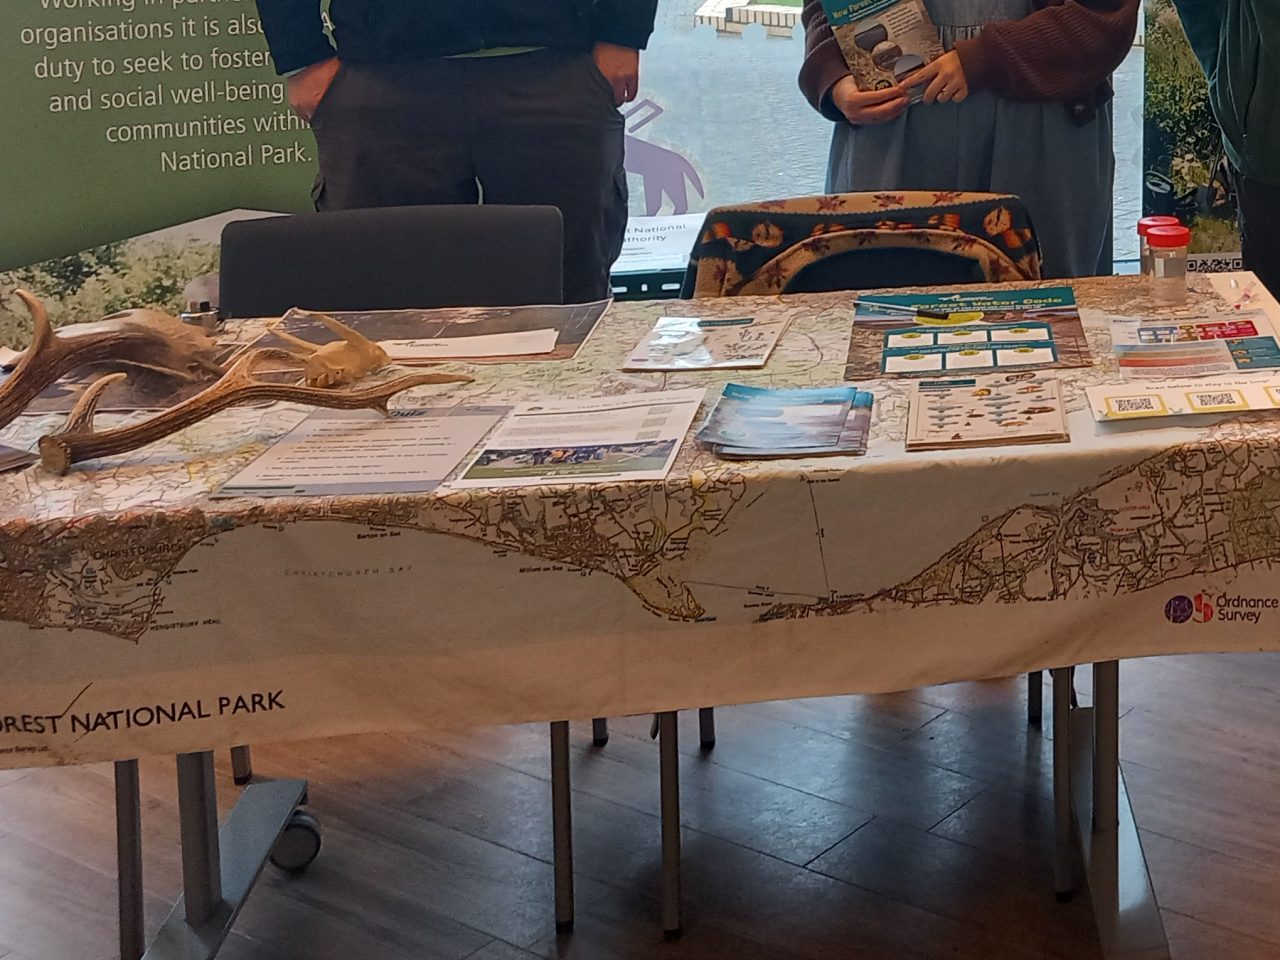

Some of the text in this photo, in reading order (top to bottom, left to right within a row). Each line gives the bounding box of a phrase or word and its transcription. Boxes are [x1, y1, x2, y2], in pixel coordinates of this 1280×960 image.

[20, 18, 173, 50] organisations
[182, 16, 196, 37] it
[204, 15, 220, 35] is
[35, 48, 270, 84] duty to seek to foster
[50, 79, 285, 113] and social well-being
[106, 117, 246, 143] communities
[161, 141, 312, 172] National Park.
[634, 223, 686, 234] National
[93, 540, 186, 560] CHRISTCHURCH
[1216, 594, 1279, 608] Ordnance
[1218, 608, 1262, 624] Survey
[0, 689, 286, 734] REST NATIONAL PARK
